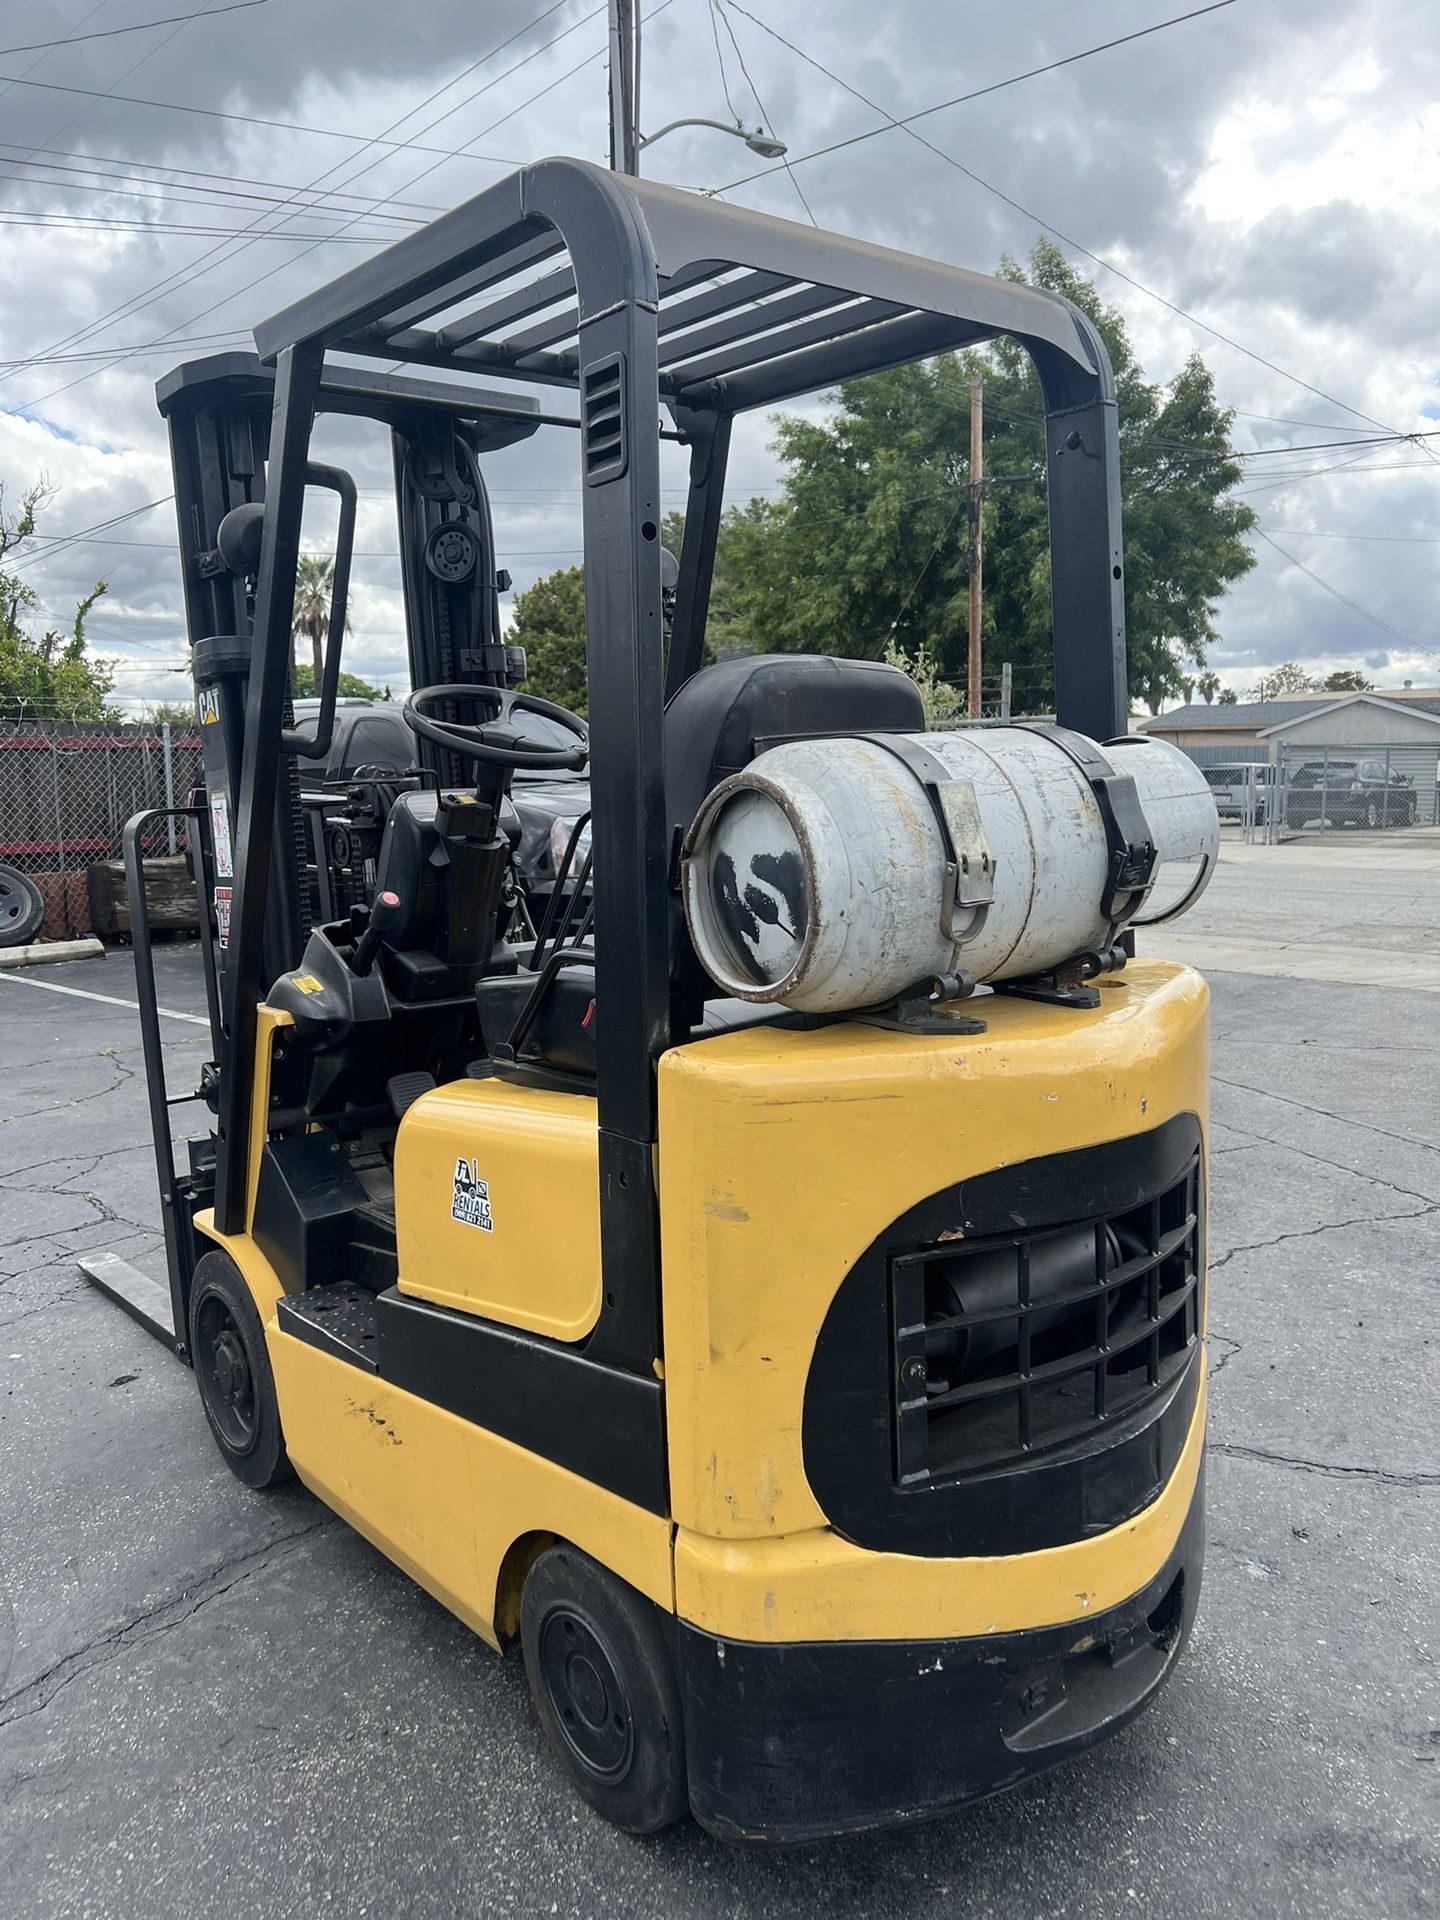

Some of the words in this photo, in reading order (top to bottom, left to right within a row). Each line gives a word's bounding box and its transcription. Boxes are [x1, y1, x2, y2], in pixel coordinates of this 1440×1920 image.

[199, 688, 220, 725] CAT
[454, 1193, 490, 1218] RENTALS
[476, 1216, 490, 1229] 2141
